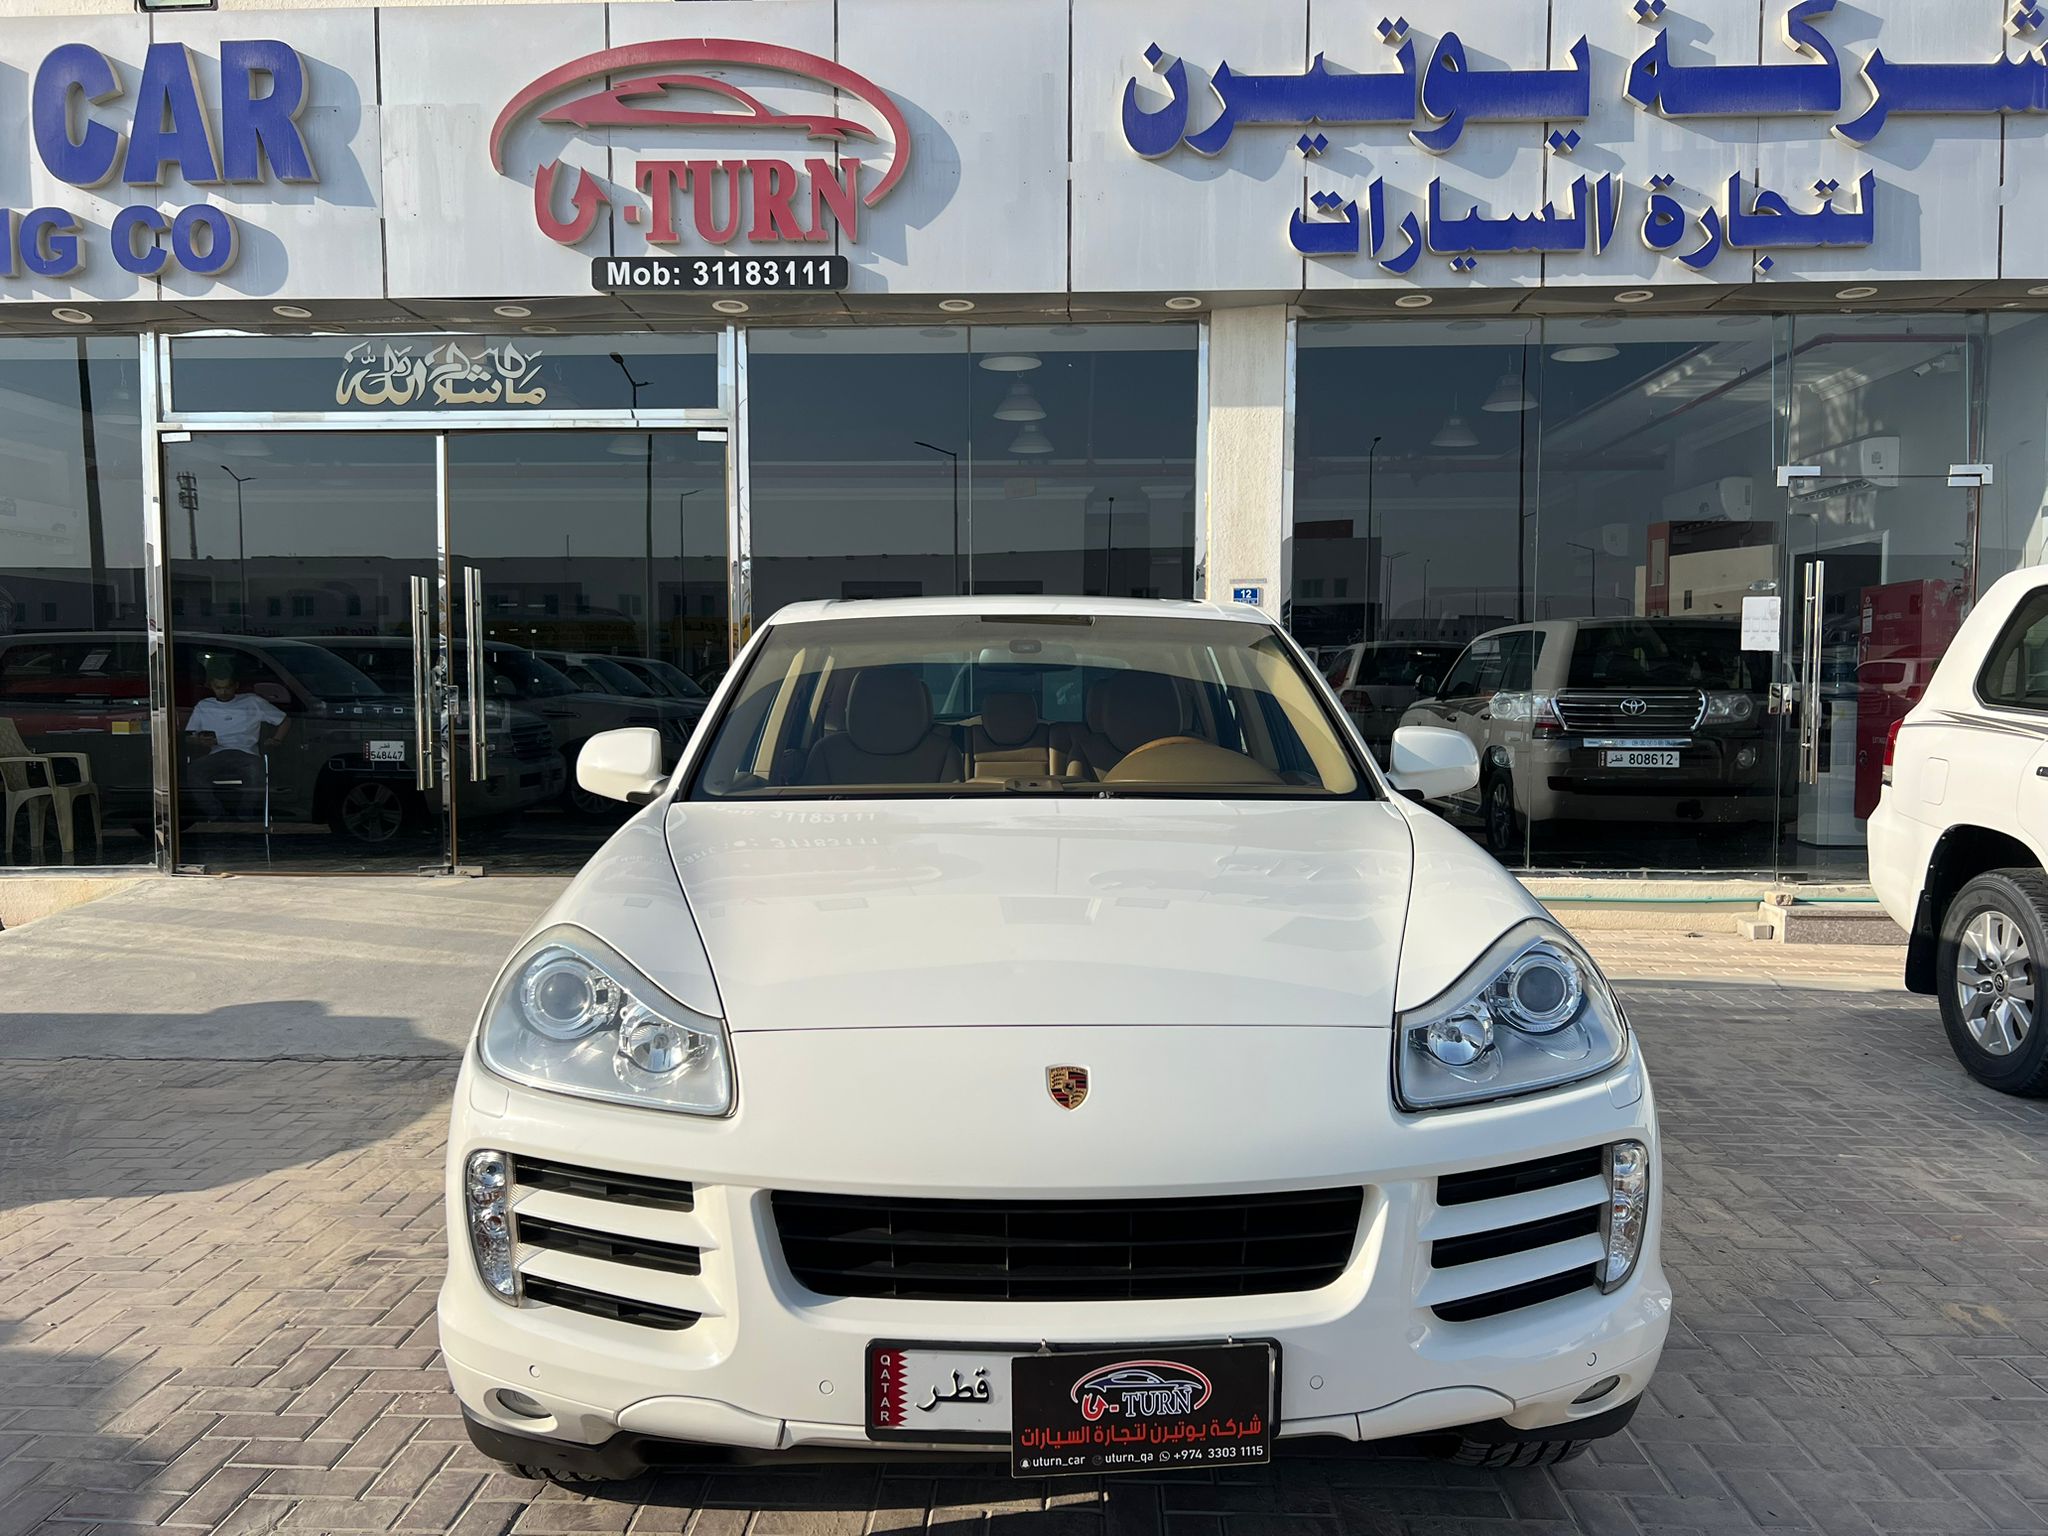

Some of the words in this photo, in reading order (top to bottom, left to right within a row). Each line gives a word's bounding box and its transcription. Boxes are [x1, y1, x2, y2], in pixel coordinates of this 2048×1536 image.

[1121, 15, 1591, 160] يوتيرن
[32, 39, 318, 186] CAR
[1289, 173, 1623, 274] السيارات
[1640, 167, 1878, 276] لتجارة
[111, 203, 240, 276] CO
[607, 261, 680, 286] Mob:
[693, 260, 831, 286] 31183111
[1240, 589, 1252, 599] 12
[370, 750, 403, 760] 548447
[1628, 753, 1674, 766] 808612
[880, 1354, 891, 1422] QATAR
[914, 1366, 991, 1412] قطر
[1020, 1426, 1090, 1450] السيارات
[1094, 1421, 1147, 1447] لتجارة
[1150, 1420, 1206, 1445] يوتيرن
[1210, 1413, 1262, 1439] شركة
[1032, 1455, 1086, 1468] uturn_car
[1105, 1452, 1154, 1465] uturn_qa
[1173, 1449, 1202, 1460] +974
[1207, 1447, 1237, 1459] 3303
[1240, 1445, 1264, 1457] 1115
